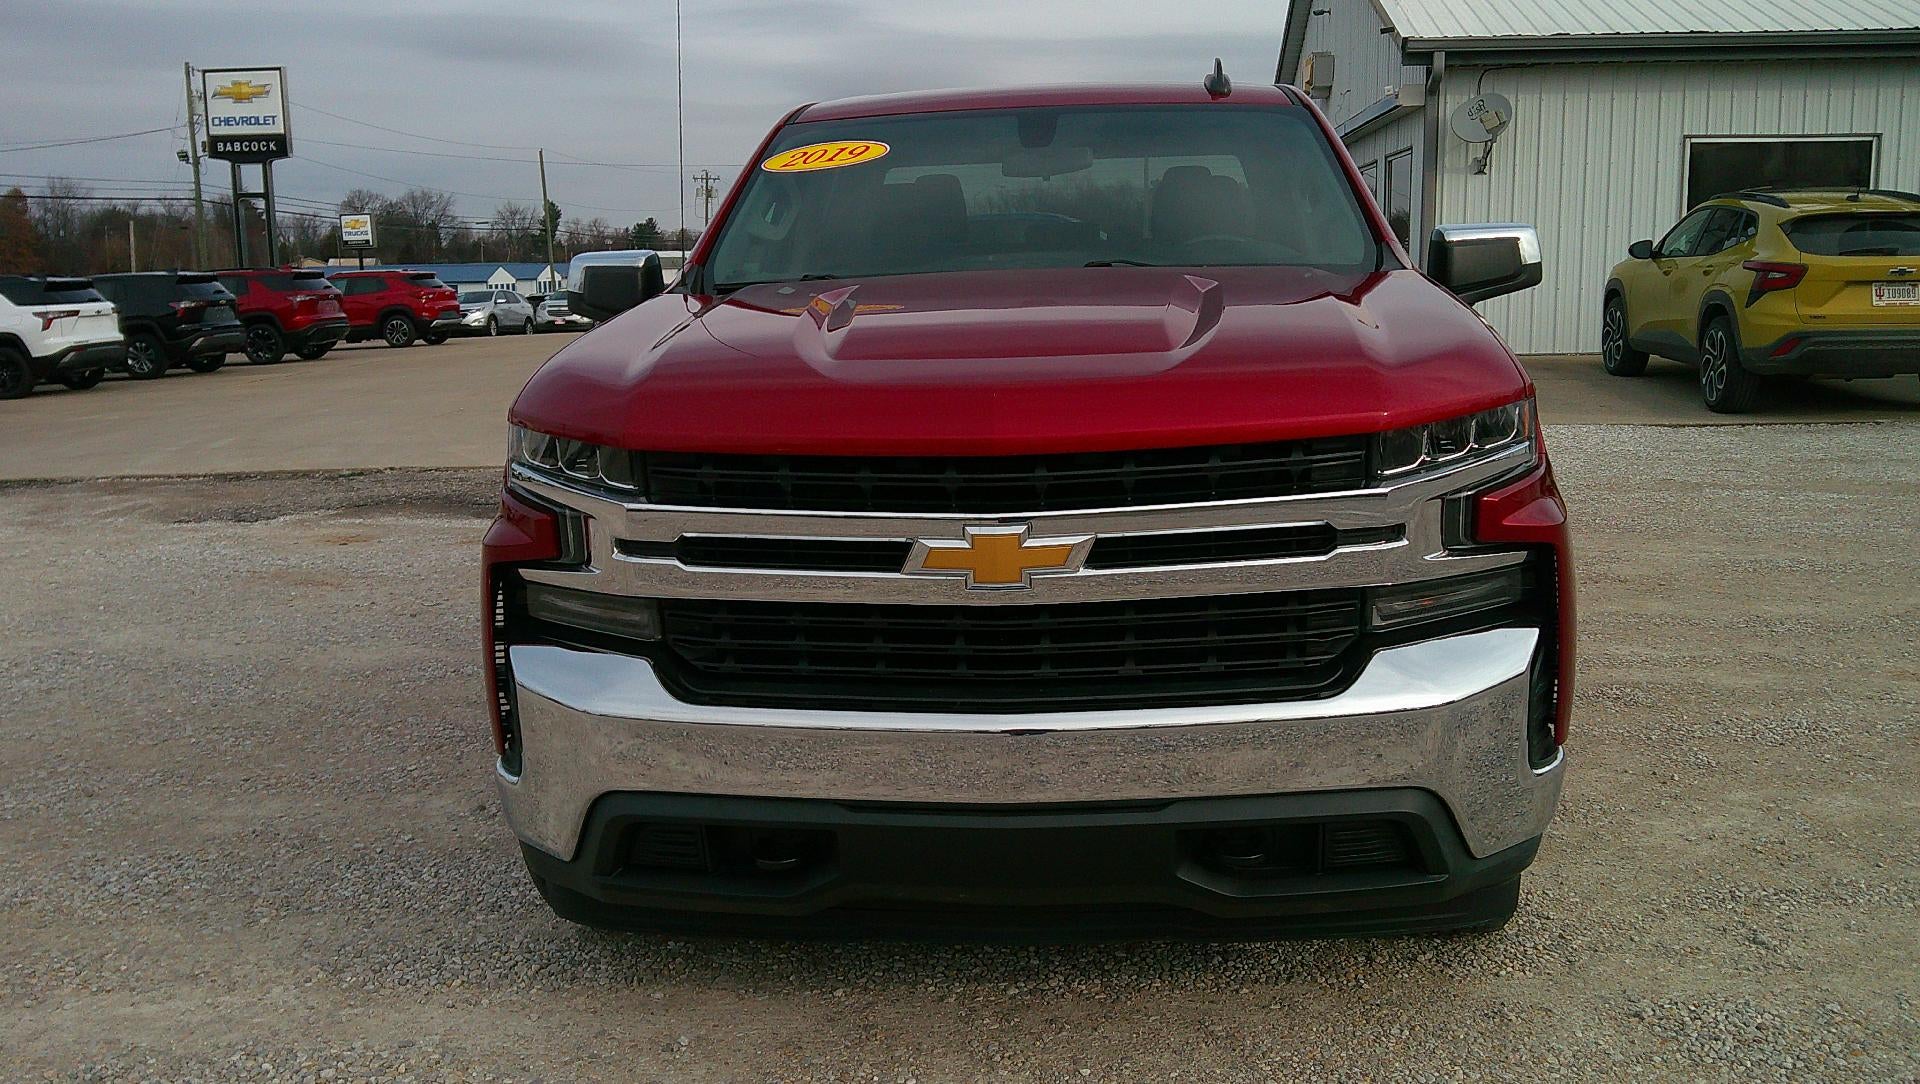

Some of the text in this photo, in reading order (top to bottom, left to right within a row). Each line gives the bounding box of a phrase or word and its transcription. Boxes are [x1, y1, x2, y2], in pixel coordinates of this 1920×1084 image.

[211, 115, 277, 127] CHEVROLET
[217, 141, 277, 152] BABCOCK
[779, 144, 871, 168] 2019
